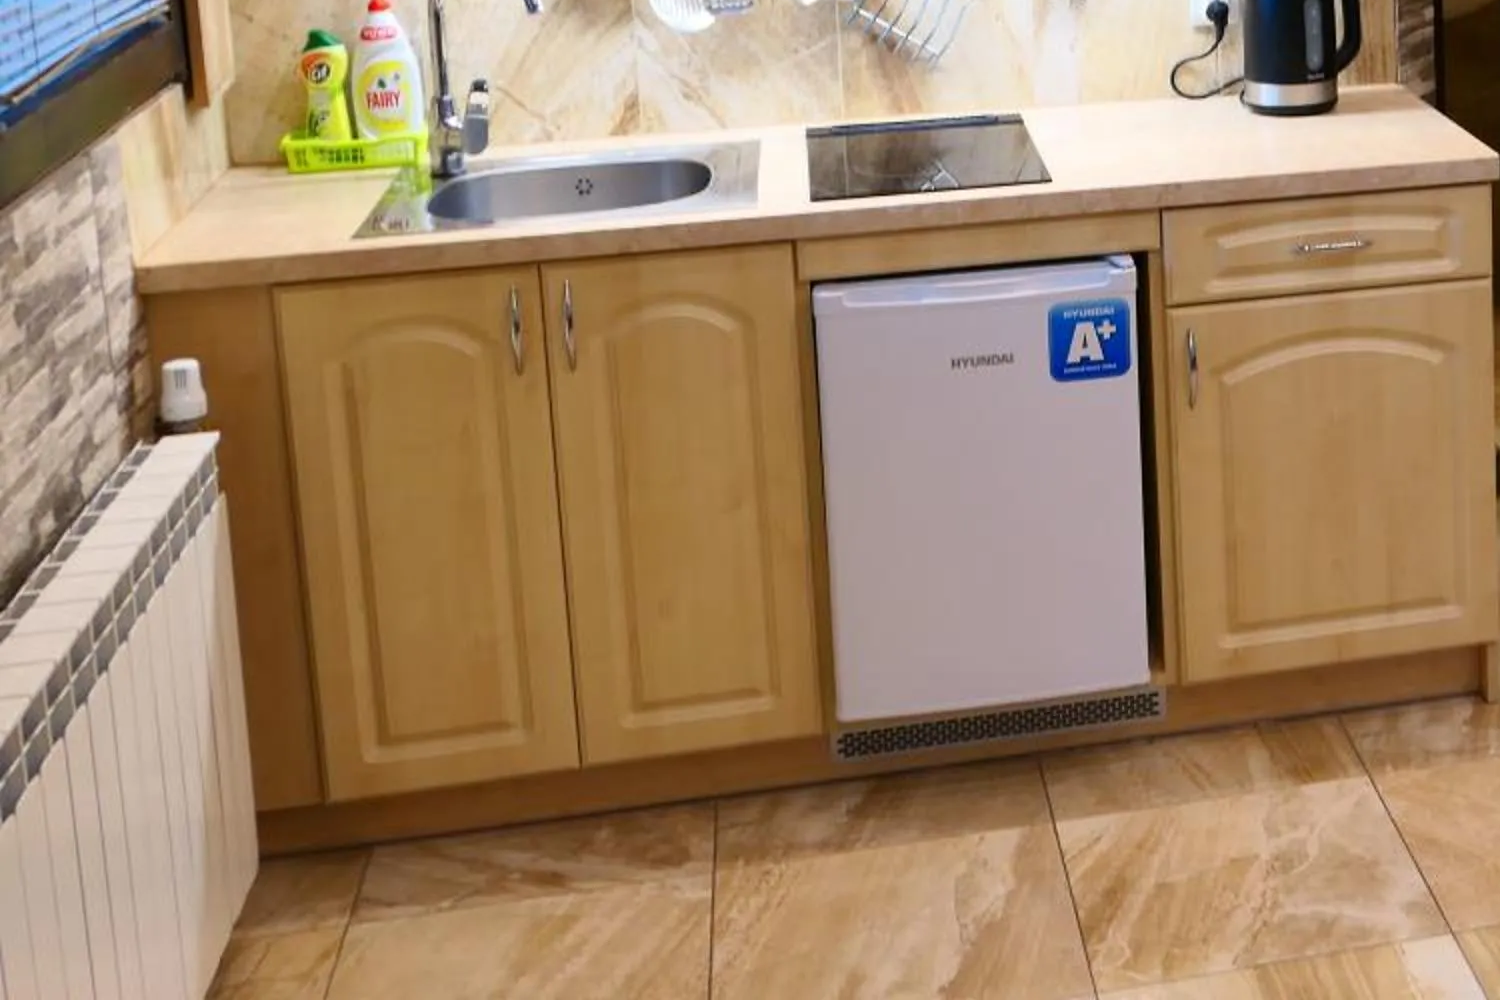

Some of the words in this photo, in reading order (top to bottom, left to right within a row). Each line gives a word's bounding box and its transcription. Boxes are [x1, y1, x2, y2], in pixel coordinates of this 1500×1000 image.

[366, 90, 400, 111] FAIRY
[1063, 304, 1115, 320] HYUNDAI
[951, 352, 1014, 371] HYUNDAI
